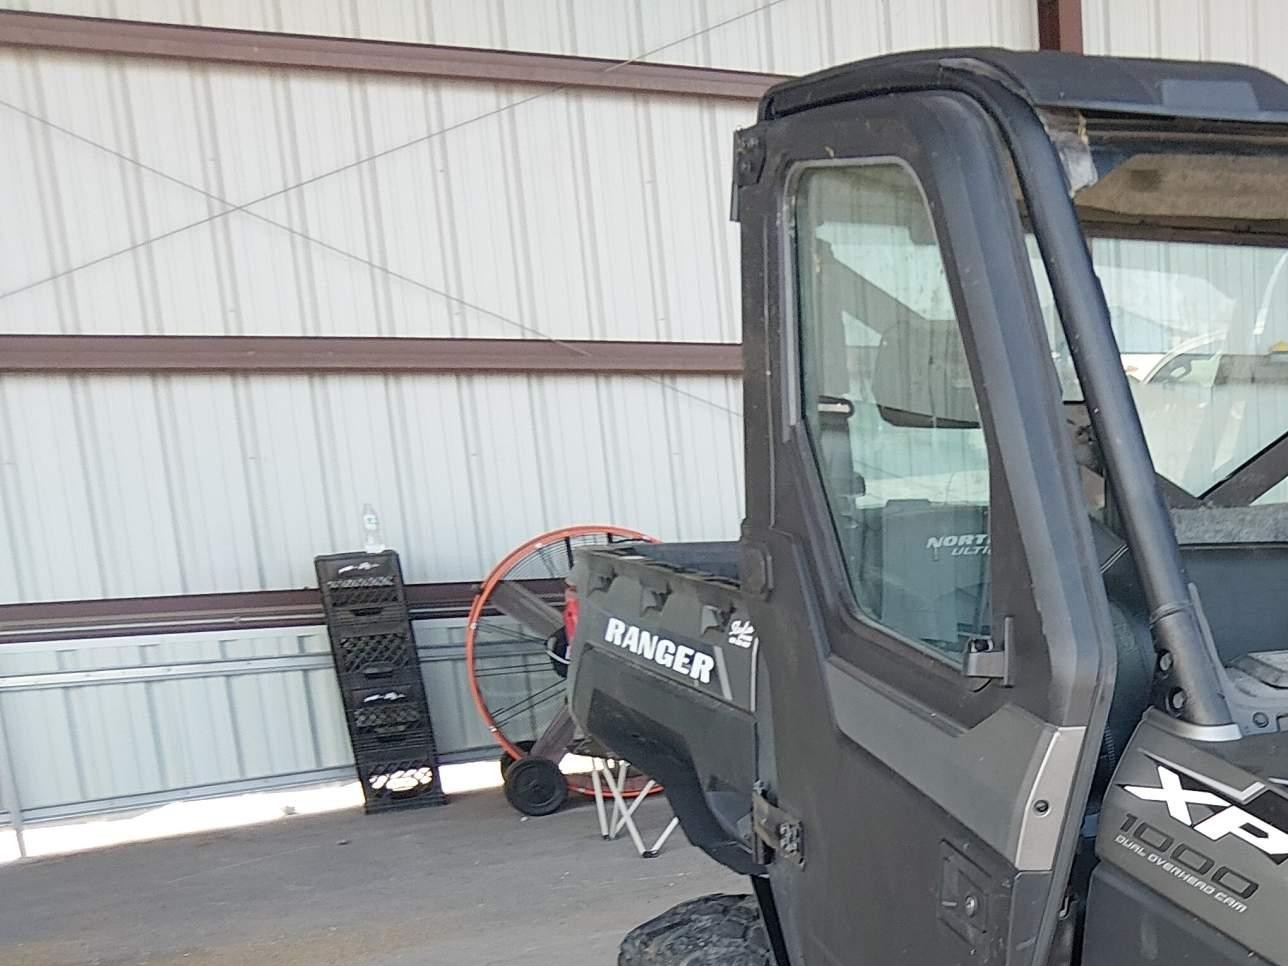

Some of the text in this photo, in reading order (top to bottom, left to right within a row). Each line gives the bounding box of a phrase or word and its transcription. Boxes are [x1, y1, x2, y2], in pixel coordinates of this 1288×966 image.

[926, 533, 991, 549] NORT
[951, 545, 991, 556] ULTI
[604, 617, 715, 684] RANGER
[1114, 833, 1248, 914] DUAL OVERHEAD CAM
[1119, 812, 1260, 900] 1000
